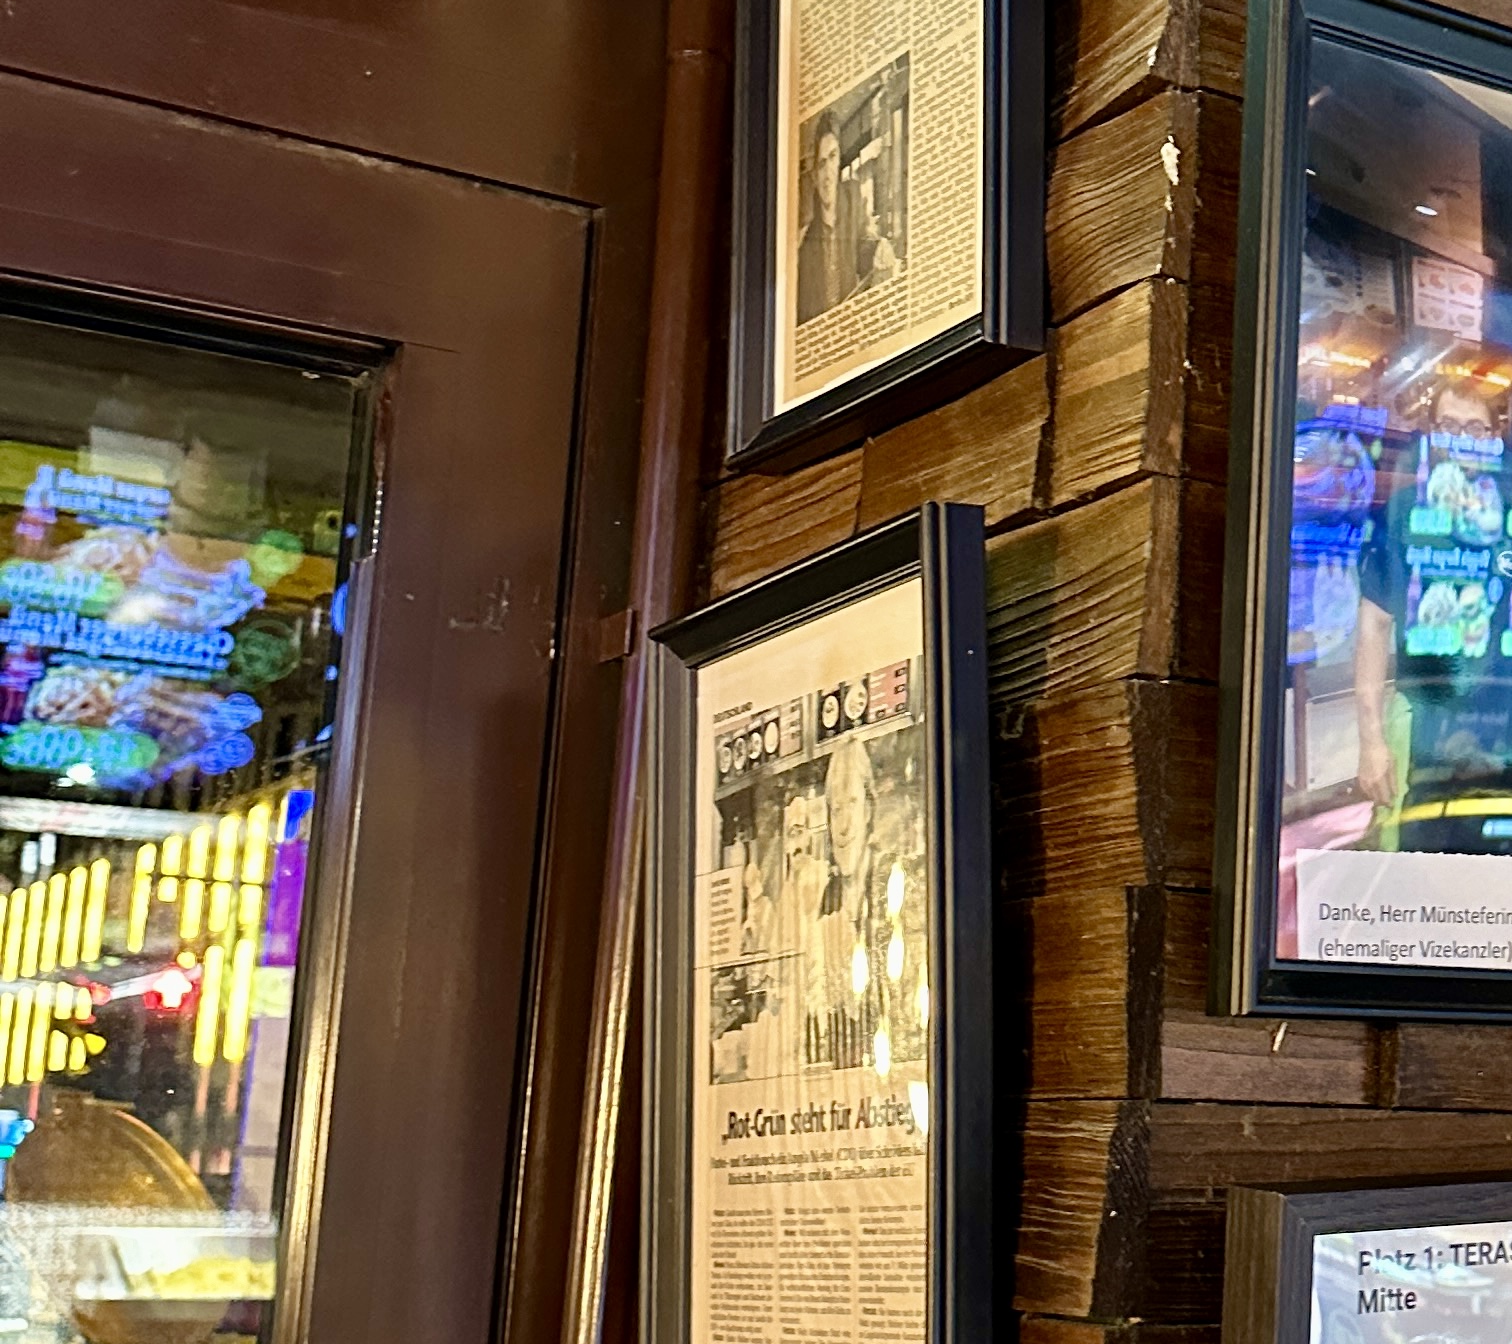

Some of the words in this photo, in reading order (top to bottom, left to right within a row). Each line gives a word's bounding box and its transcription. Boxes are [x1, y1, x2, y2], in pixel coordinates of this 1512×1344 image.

[1318, 902, 1375, 925] Danke,
[1380, 904, 1415, 923] Herr
[1318, 937, 1416, 960] (ehemaliger
[790, 1102, 826, 1135] steht
[830, 1100, 852, 1131] für
[1423, 1246, 1444, 1270] 1:
[1357, 1287, 1417, 1315] Mitte
